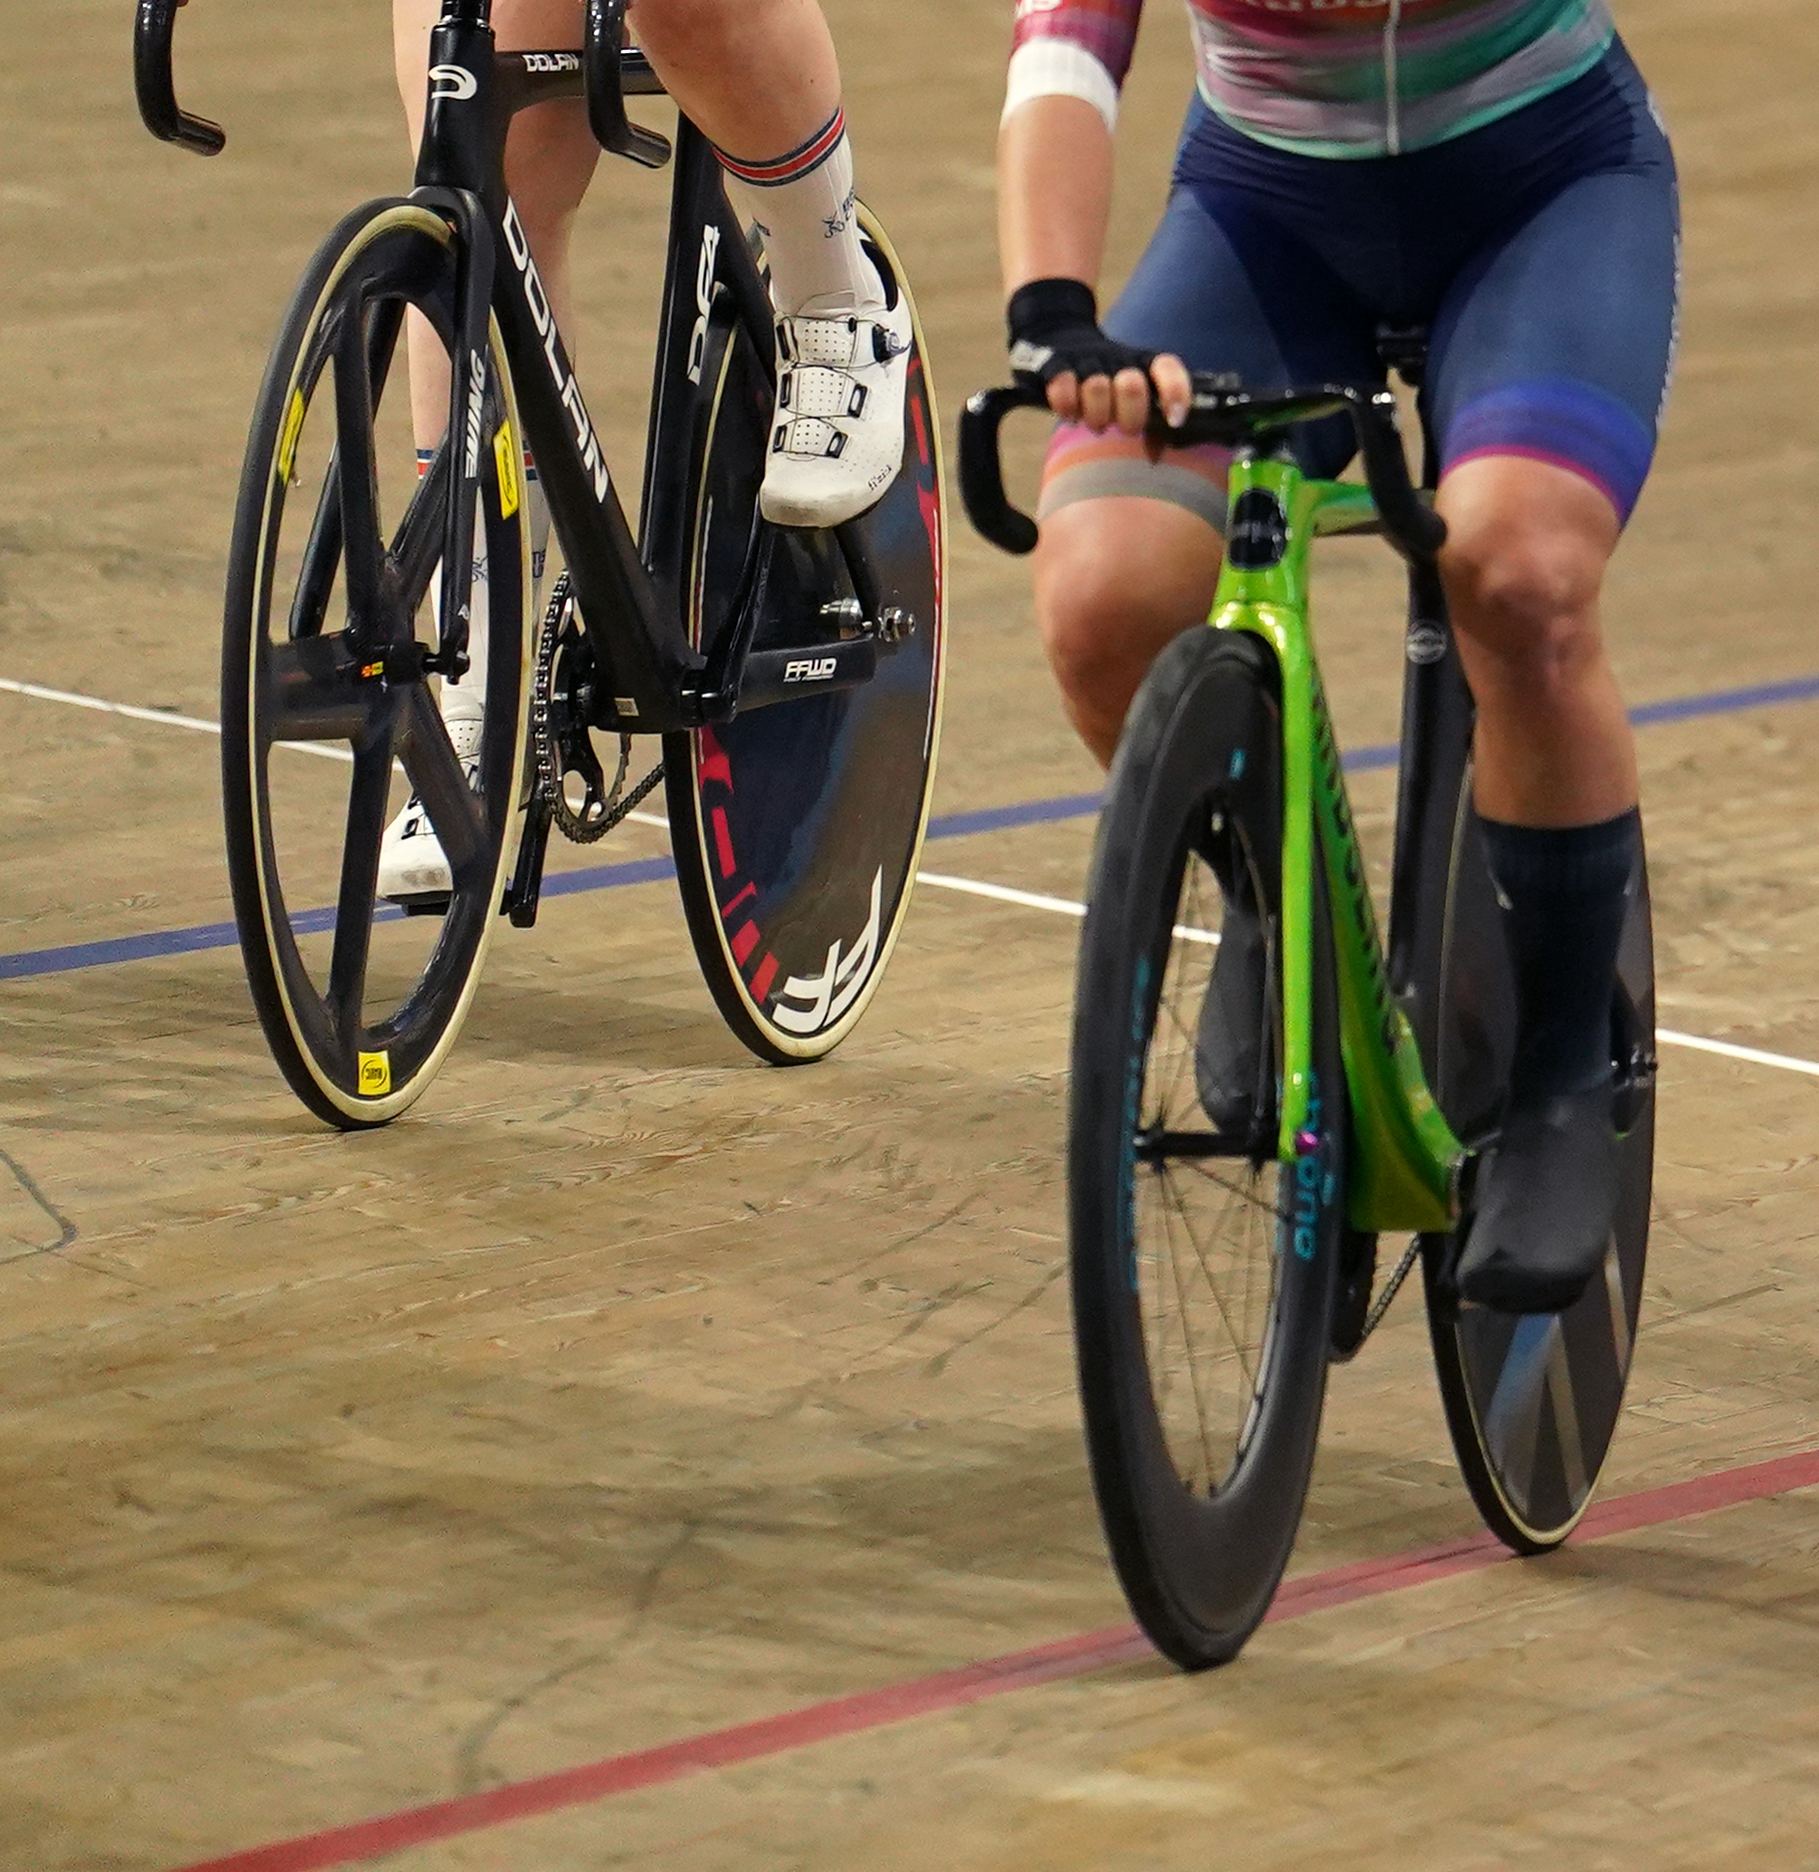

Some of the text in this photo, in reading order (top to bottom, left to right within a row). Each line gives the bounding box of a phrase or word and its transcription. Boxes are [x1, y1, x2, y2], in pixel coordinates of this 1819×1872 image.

[522, 54, 579, 72] DOLAN
[502, 194, 609, 504] DOLAN
[785, 657, 837, 678] FFWD
